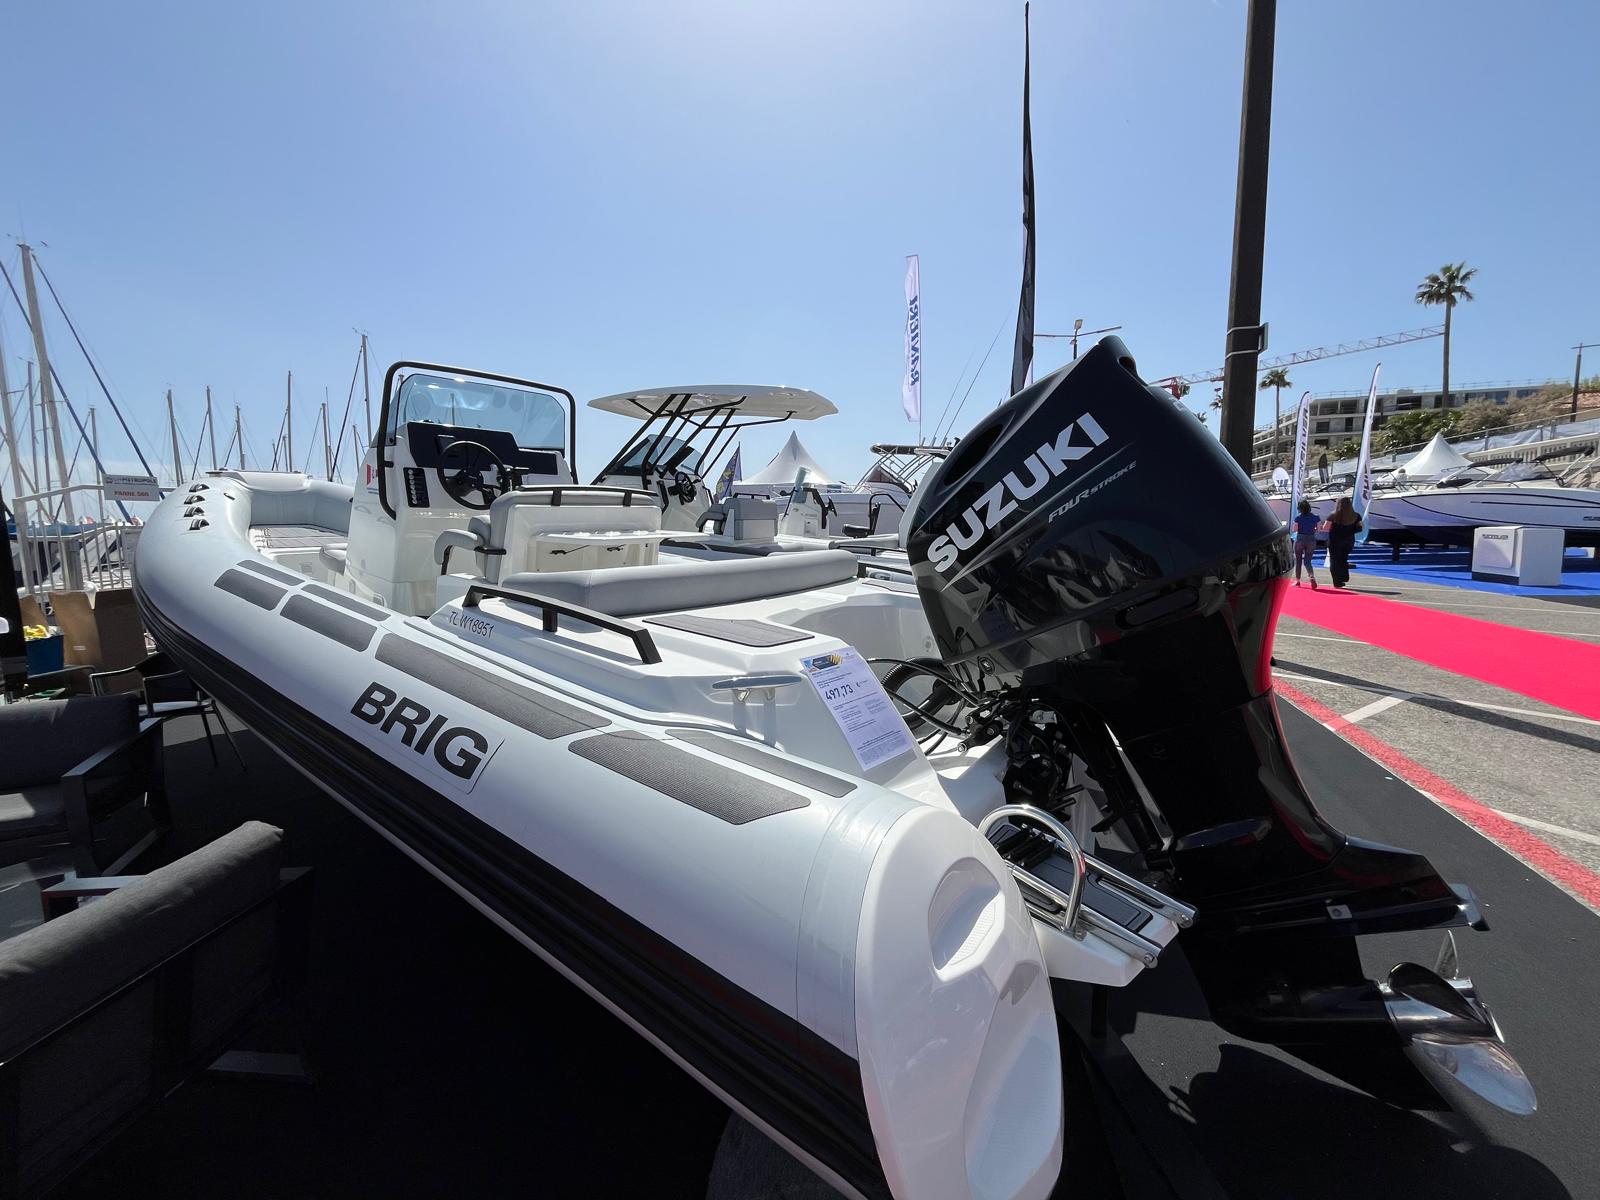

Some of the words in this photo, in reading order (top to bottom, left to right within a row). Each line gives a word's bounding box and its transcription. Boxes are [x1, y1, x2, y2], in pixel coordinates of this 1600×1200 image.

[927, 412, 1109, 572] SUZUKI
[449, 611, 458, 626] TL
[460, 614, 494, 638] W18951
[825, 684, 853, 700] 497,73
[350, 681, 489, 780] BRIG
